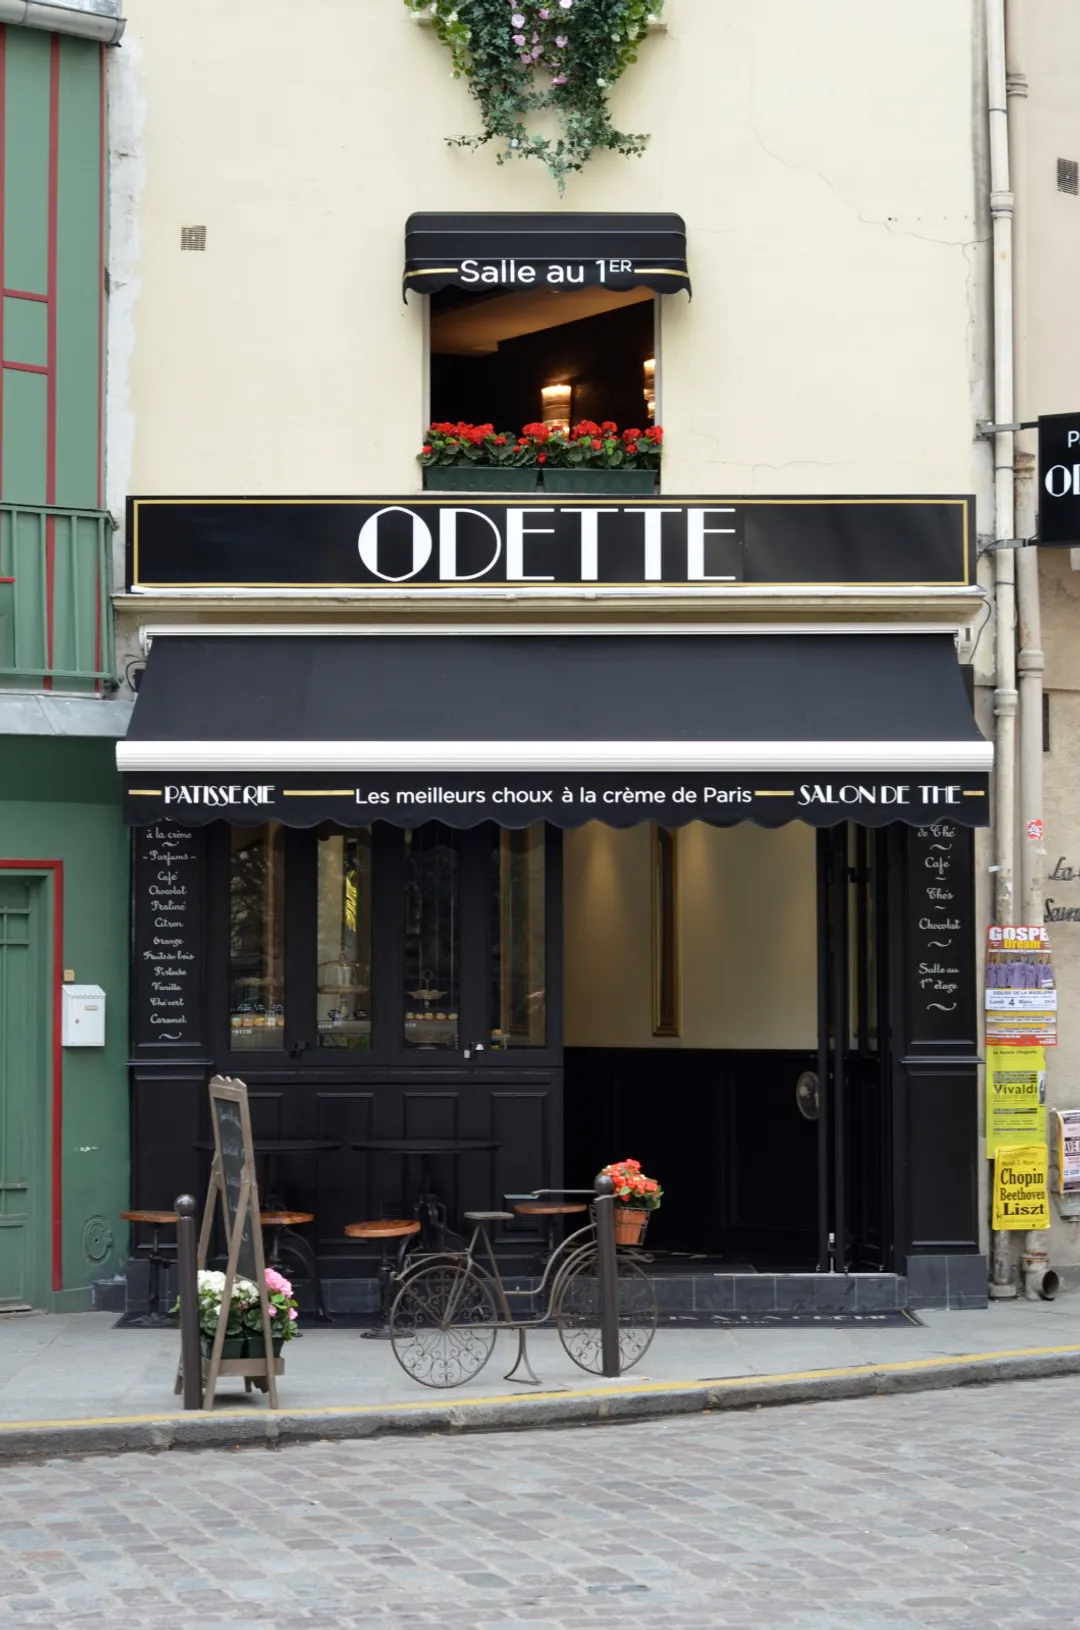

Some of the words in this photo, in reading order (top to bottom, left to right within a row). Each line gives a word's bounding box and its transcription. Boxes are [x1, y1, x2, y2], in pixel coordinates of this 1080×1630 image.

[460, 260, 536, 283] Salle
[546, 265, 585, 283] au
[595, 260, 632, 283] 1ER
[1067, 430, 1080, 448] P
[358, 506, 736, 582] ODETTE
[164, 785, 276, 806] PATISSERIE
[355, 788, 390, 804] Les
[396, 787, 486, 804] meilleurs
[492, 787, 553, 803] choux
[561, 787, 573, 803] à
[580, 787, 596, 803] la
[602, 787, 666, 803] crème
[671, 787, 697, 803] de
[703, 787, 752, 803] Paris
[797, 784, 876, 806] SALON
[880, 785, 910, 804] DE
[917, 785, 961, 804] THE
[155, 826, 167, 839] la
[167, 830, 192, 839] crème
[917, 828, 928, 837] de
[930, 824, 956, 837] Thé
[149, 849, 189, 866] Parfums
[924, 855, 951, 875] Café
[157, 871, 178, 886] Café
[149, 885, 187, 895] Chocolat
[926, 887, 955, 900] Thés
[151, 900, 187, 911] Praliné
[154, 917, 184, 928] Citron
[918, 917, 961, 930] Chocolat
[988, 926, 1050, 942] GOSPE
[153, 936, 184, 947] Orange
[1003, 938, 1041, 949] Dream
[177, 950, 195, 960] bois
[154, 966, 187, 976] Pistache
[918, 962, 946, 974] Salle
[151, 981, 183, 991] Vanille
[149, 997, 167, 1006] Thé
[168, 997, 185, 1006] vert
[1008, 998, 1015, 1006] 4
[150, 1013, 188, 1024] Caramel
[993, 1084, 1038, 1095] Vivaldi
[1000, 1167, 1044, 1188] Chopin
[1000, 1187, 1046, 1201] Beethoven
[1003, 1202, 1045, 1216] Liszt
